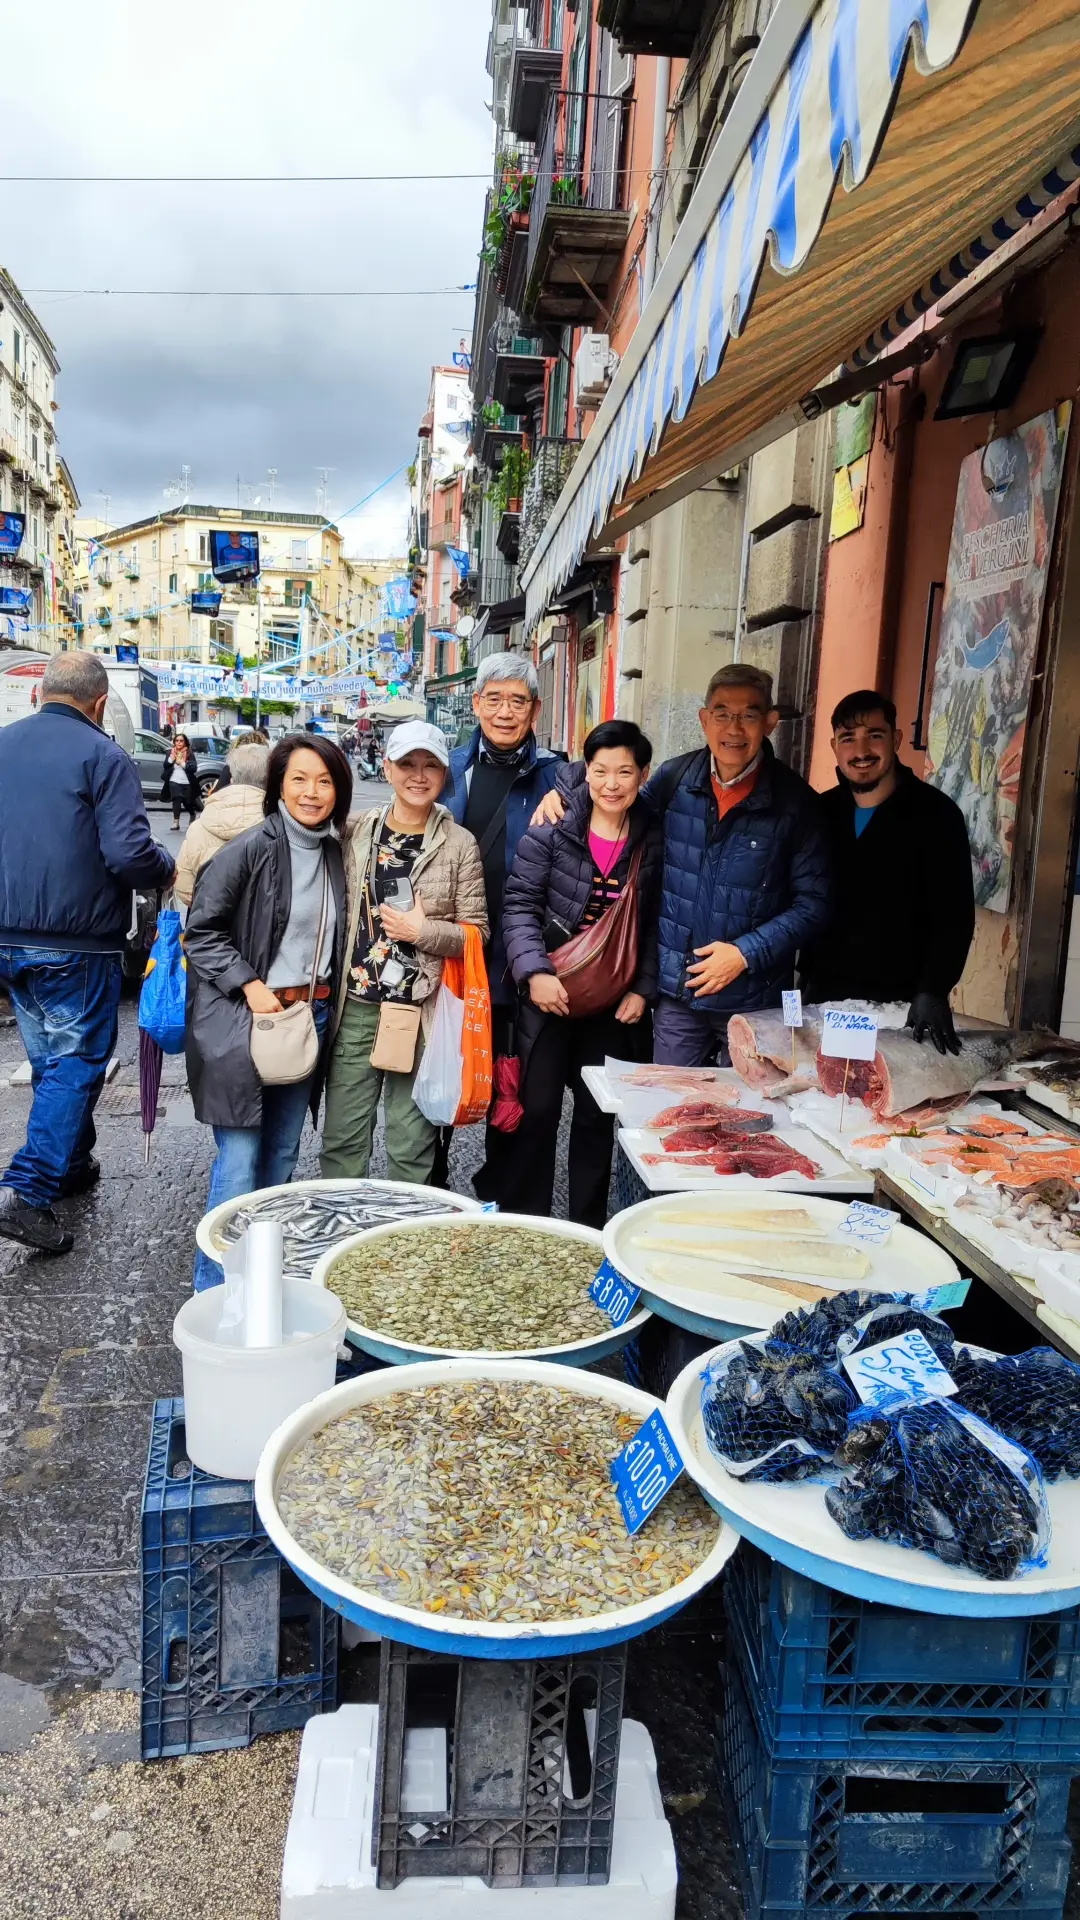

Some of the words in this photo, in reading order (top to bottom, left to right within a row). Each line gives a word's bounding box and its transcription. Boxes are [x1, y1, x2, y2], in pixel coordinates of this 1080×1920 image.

[9, 518, 23, 533] 13
[961, 510, 1029, 558] PESCHERIA
[241, 536, 258, 549] 22
[975, 537, 1029, 577] VERGINI
[825, 1011, 870, 1023] TONNO
[655, 1427, 679, 1472] PACHIALONE
